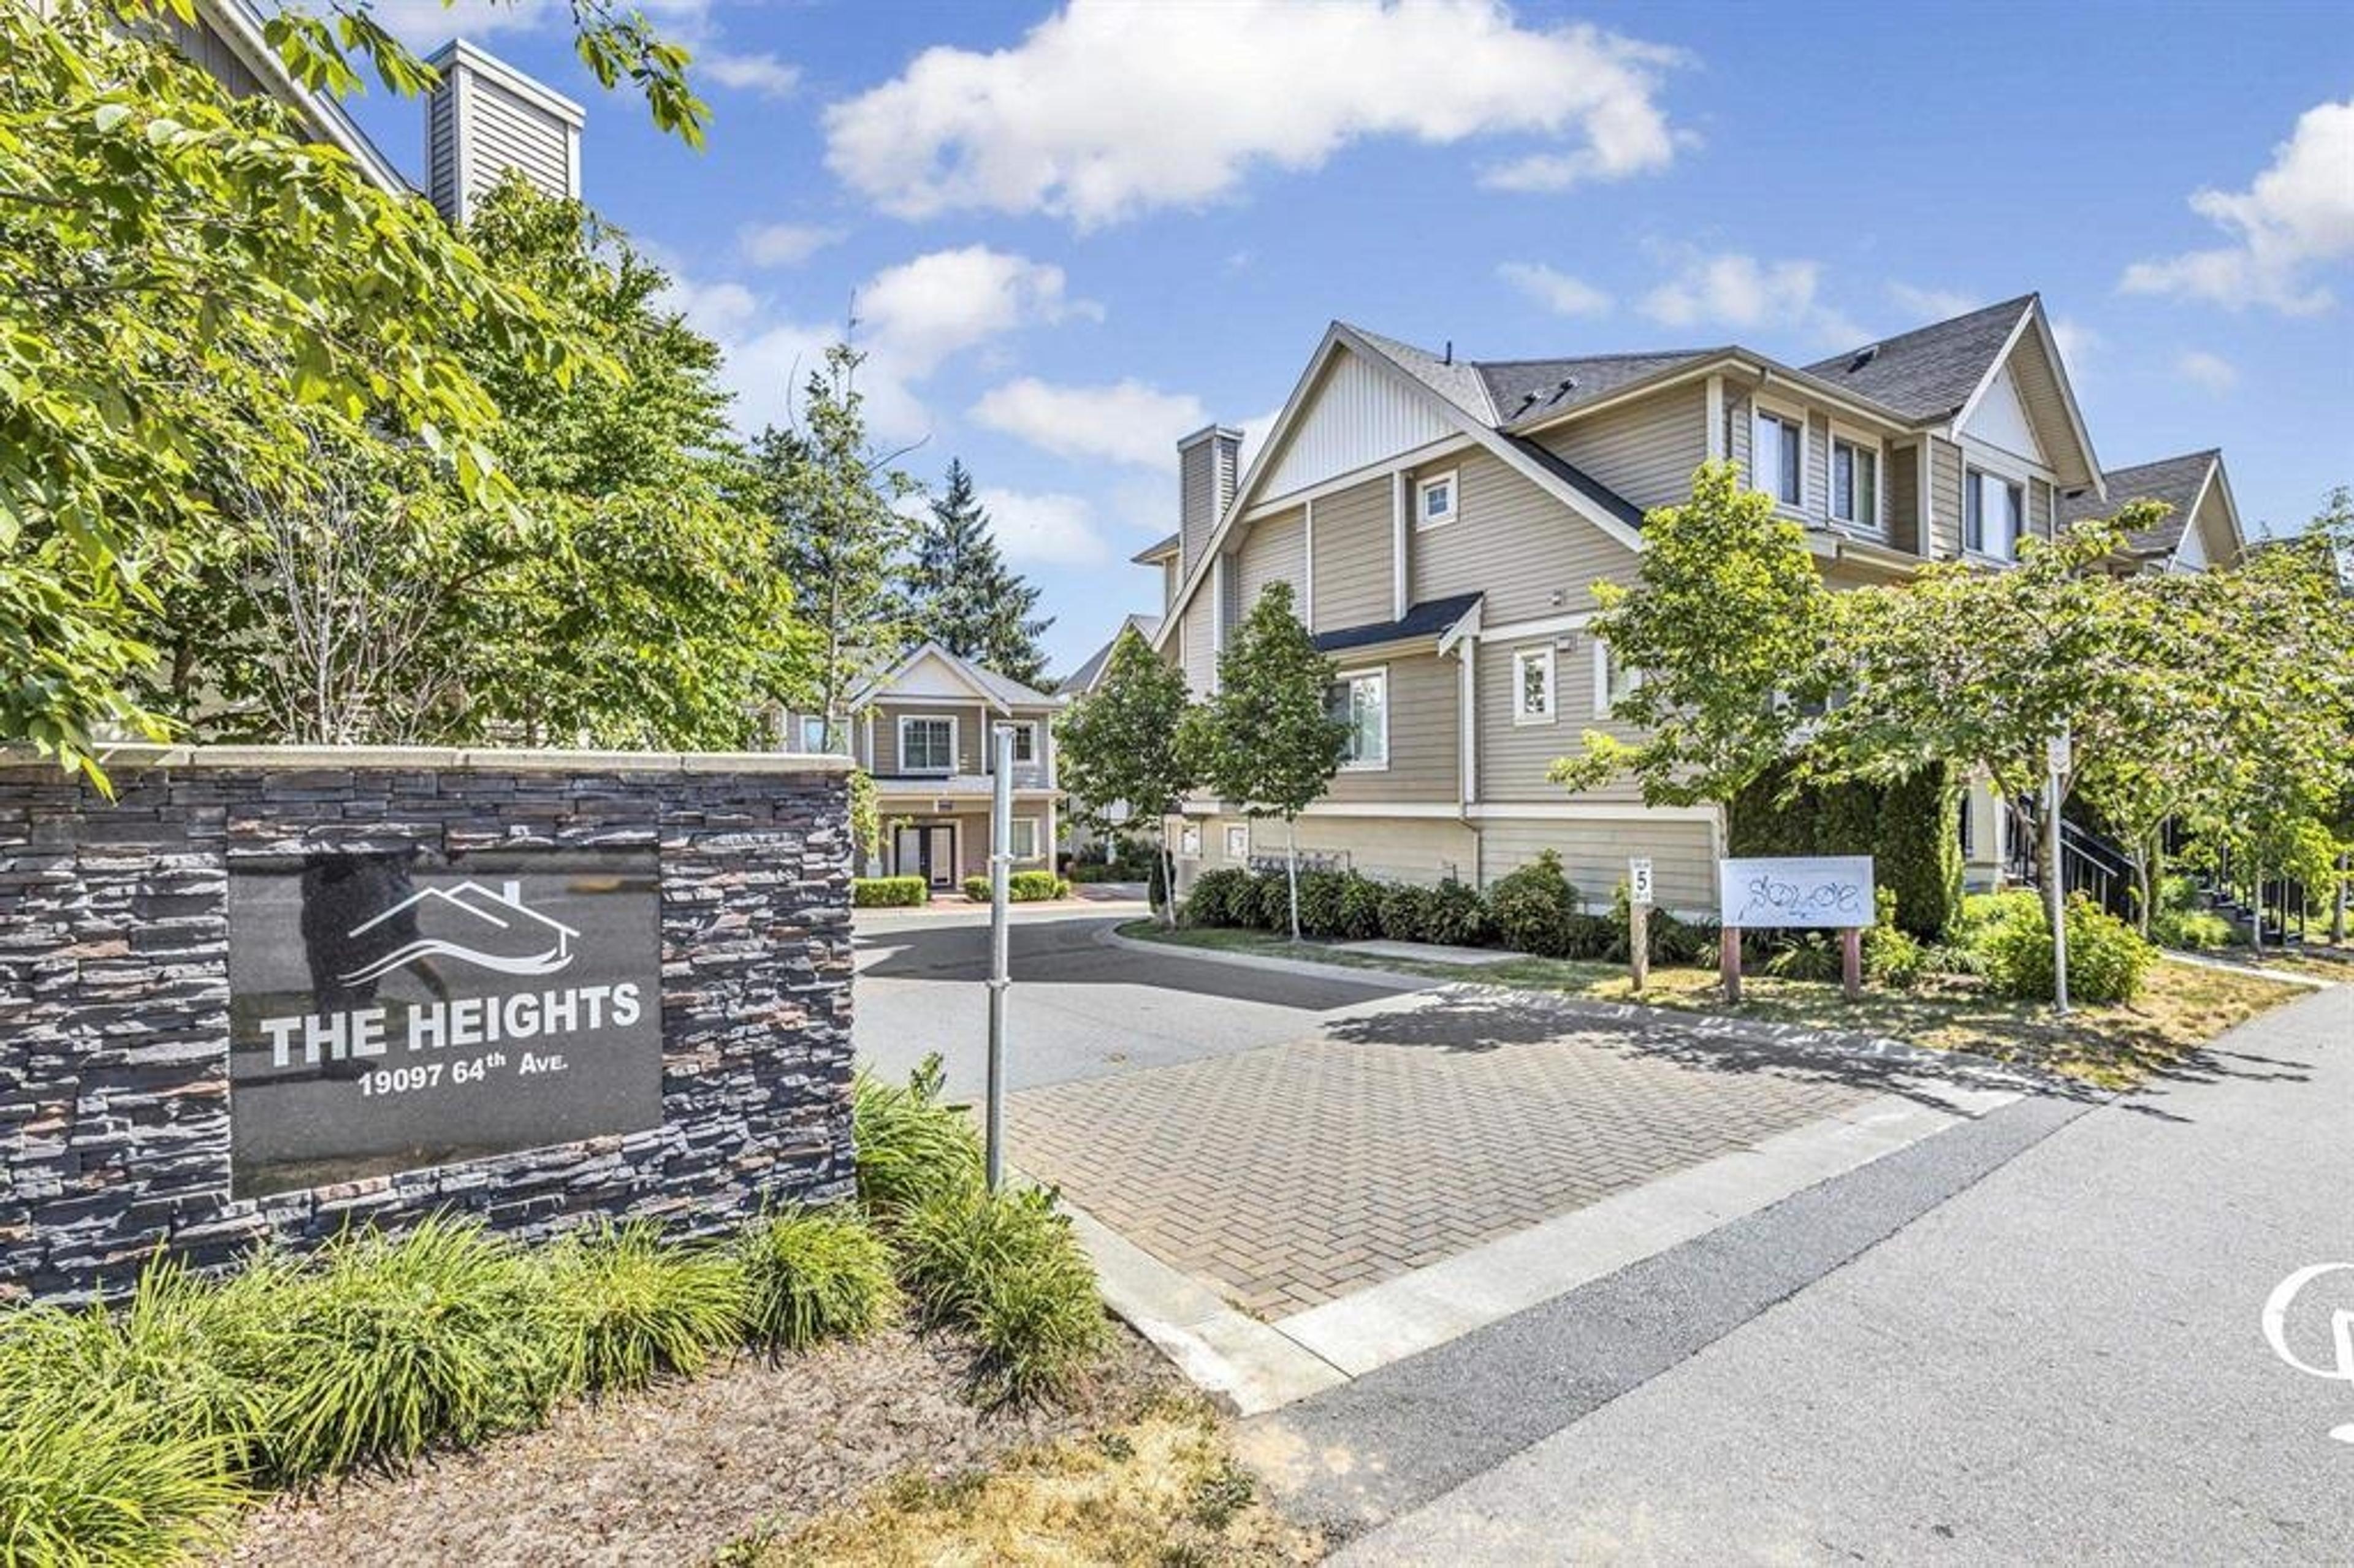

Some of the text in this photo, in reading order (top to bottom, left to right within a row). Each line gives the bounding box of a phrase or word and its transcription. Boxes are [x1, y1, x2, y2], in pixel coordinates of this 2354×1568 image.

[1637, 871, 1647, 891] 5
[260, 983, 641, 1067] THE HEIGHTS
[358, 1064, 443, 1096] 19097
[452, 1052, 506, 1084] 64th
